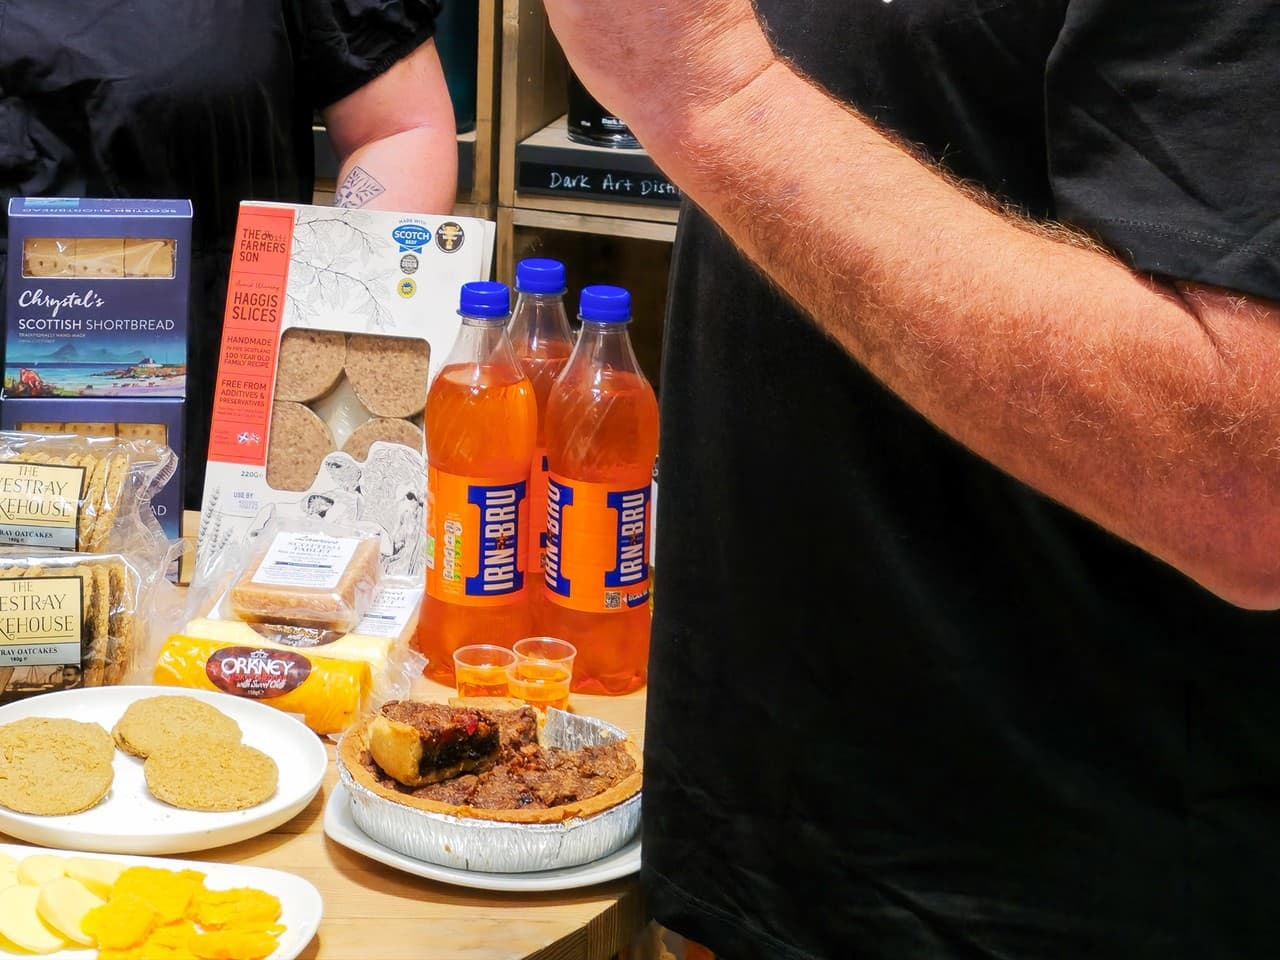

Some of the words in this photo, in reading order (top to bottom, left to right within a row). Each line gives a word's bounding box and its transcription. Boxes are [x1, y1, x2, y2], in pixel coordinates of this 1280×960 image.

[549, 172, 591, 188] Dark
[602, 174, 633, 190] Art
[242, 228, 261, 240] THE
[394, 230, 430, 241] SCOTCH
[240, 240, 286, 254] FARMERS
[240, 251, 259, 262] SON
[18, 288, 104, 317] Chrystal's
[234, 291, 278, 308] HAGGIS
[232, 306, 277, 323] SLICES
[18, 319, 81, 330] SCOTTISH
[86, 319, 175, 330] SHORTBREAD
[227, 335, 272, 347] HANDMADE
[225, 351, 238, 359] 100
[240, 352, 256, 361] YEAR
[224, 358, 246, 368] FAMILY
[247, 360, 269, 369] RECIPE
[222, 379, 241, 389] FREE
[243, 381, 266, 391] FROM
[221, 388, 258, 399] ADDITIVES
[220, 397, 265, 408] PRESERVATIVES
[18, 466, 38, 477] THE
[15, 530, 53, 538] OATCAKES
[12, 581, 33, 593] THE
[17, 646, 58, 655] OATCAKES
[221, 658, 295, 676] ORKNEY
